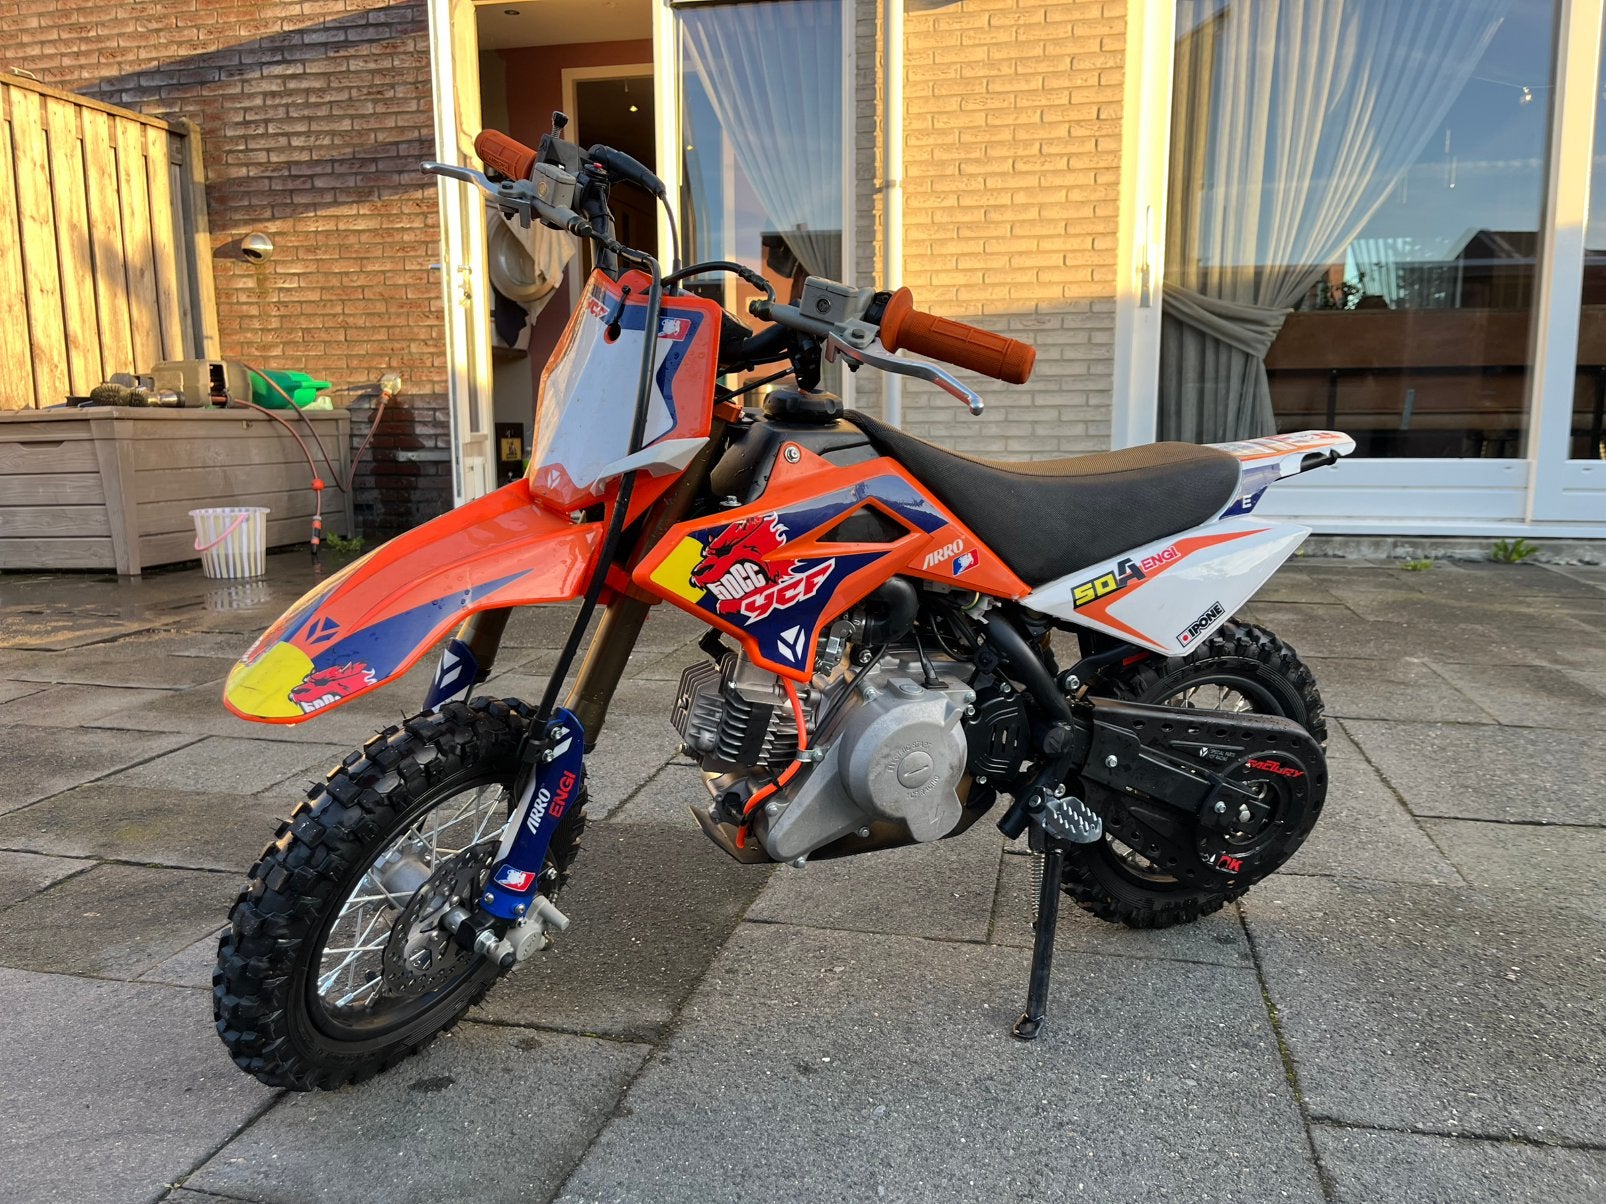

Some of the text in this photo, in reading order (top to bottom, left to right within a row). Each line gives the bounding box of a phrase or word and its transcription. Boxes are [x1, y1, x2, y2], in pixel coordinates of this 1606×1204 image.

[922, 538, 964, 570] ARRO
[1140, 546, 1181, 571] ENGI
[740, 558, 836, 626] YCF
[1189, 604, 1223, 637] IPONE
[526, 788, 551, 835] ARRO
[549, 770, 577, 818] ENGI
